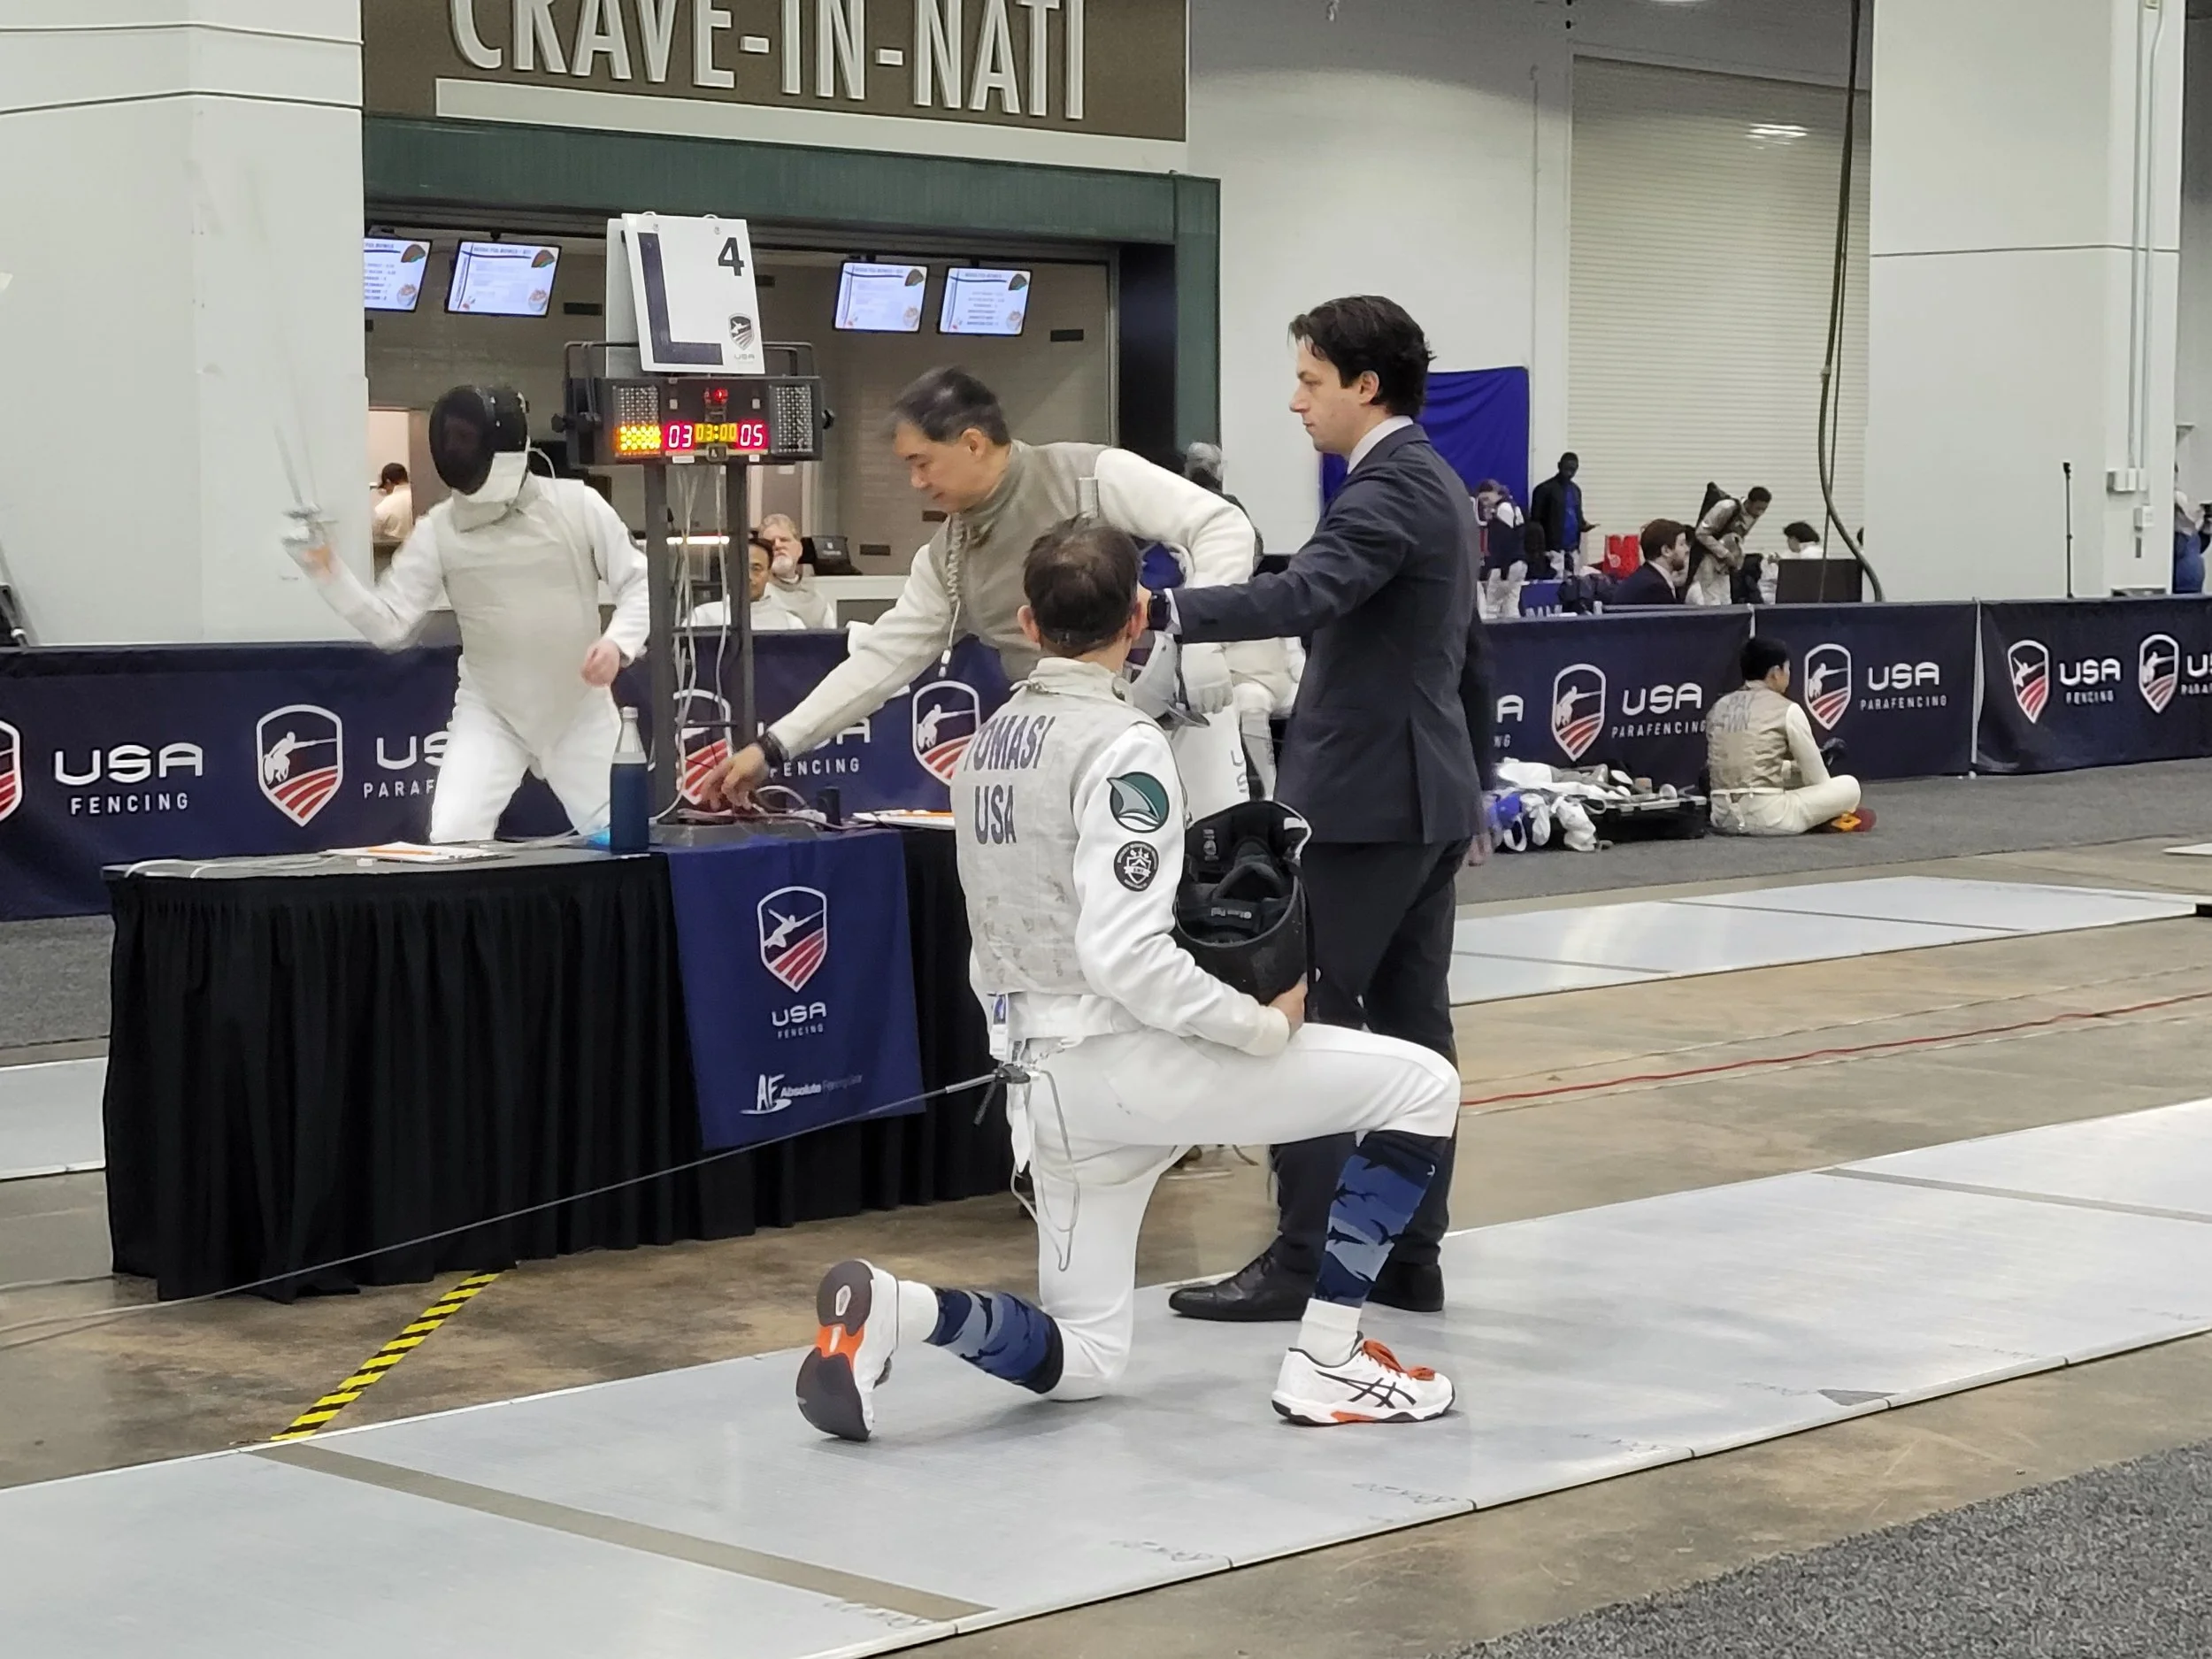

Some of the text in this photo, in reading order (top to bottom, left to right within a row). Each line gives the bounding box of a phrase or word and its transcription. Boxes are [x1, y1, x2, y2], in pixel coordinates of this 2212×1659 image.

[718, 237, 745, 277] 4
[637, 232, 723, 365] L
[668, 423, 764, 448] 03 03:00 05
[1867, 661, 1939, 690] USA
[2060, 657, 2121, 687] USA
[1622, 682, 1702, 717] USA
[1861, 694, 1947, 711] PARAFENCING
[2066, 689, 2114, 705] FENCING
[1611, 719, 1707, 739] PARAFENCING
[54, 742, 204, 787] USA
[376, 730, 450, 771] US
[70, 792, 189, 816] FENCING
[975, 784, 1017, 845] USA
[772, 1002, 827, 1027] USA
[777, 1023, 824, 1040] FENCING
